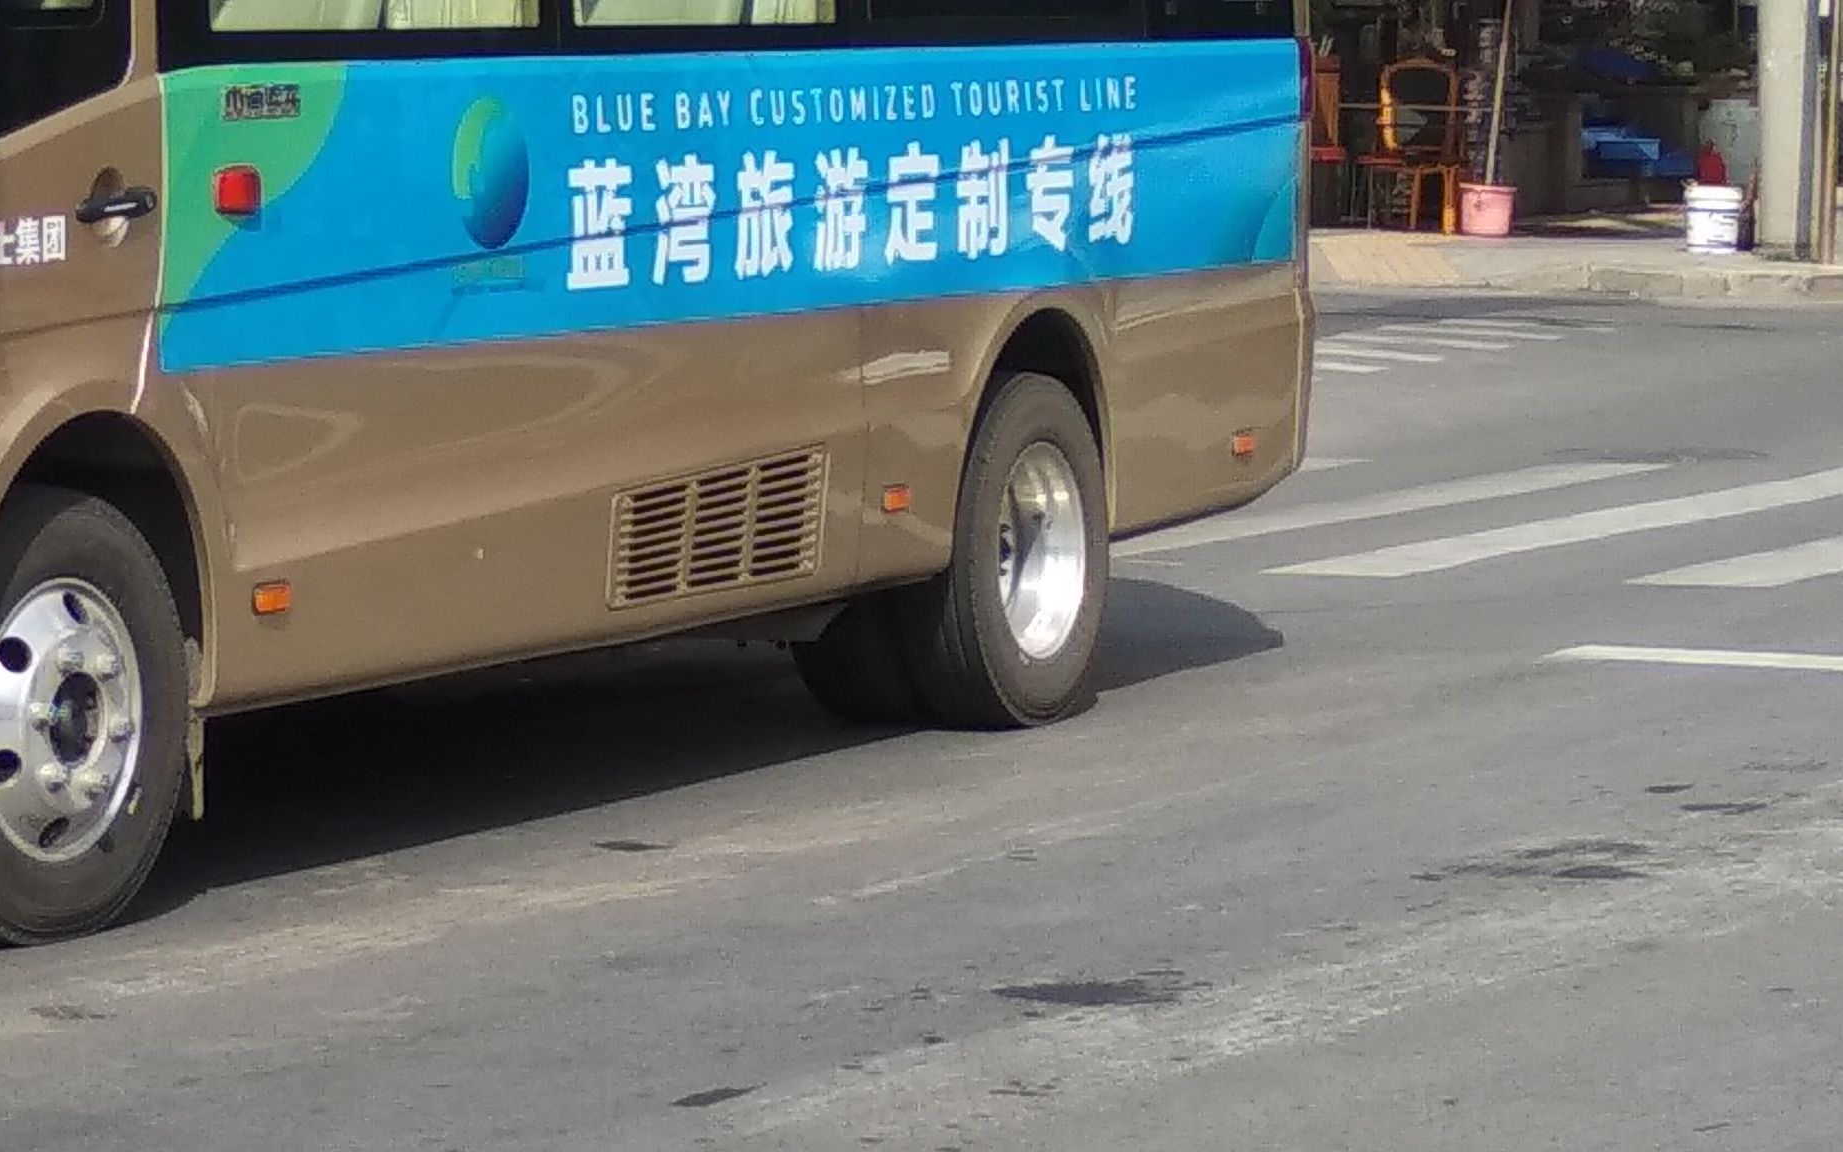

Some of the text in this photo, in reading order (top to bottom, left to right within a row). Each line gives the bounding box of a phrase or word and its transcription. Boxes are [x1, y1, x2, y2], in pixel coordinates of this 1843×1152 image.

[571, 75, 1138, 133] BLUE BAY CUSTOMIZED TOURIST LINE
[566, 134, 1135, 289] 蓝湾旅游定制专线
